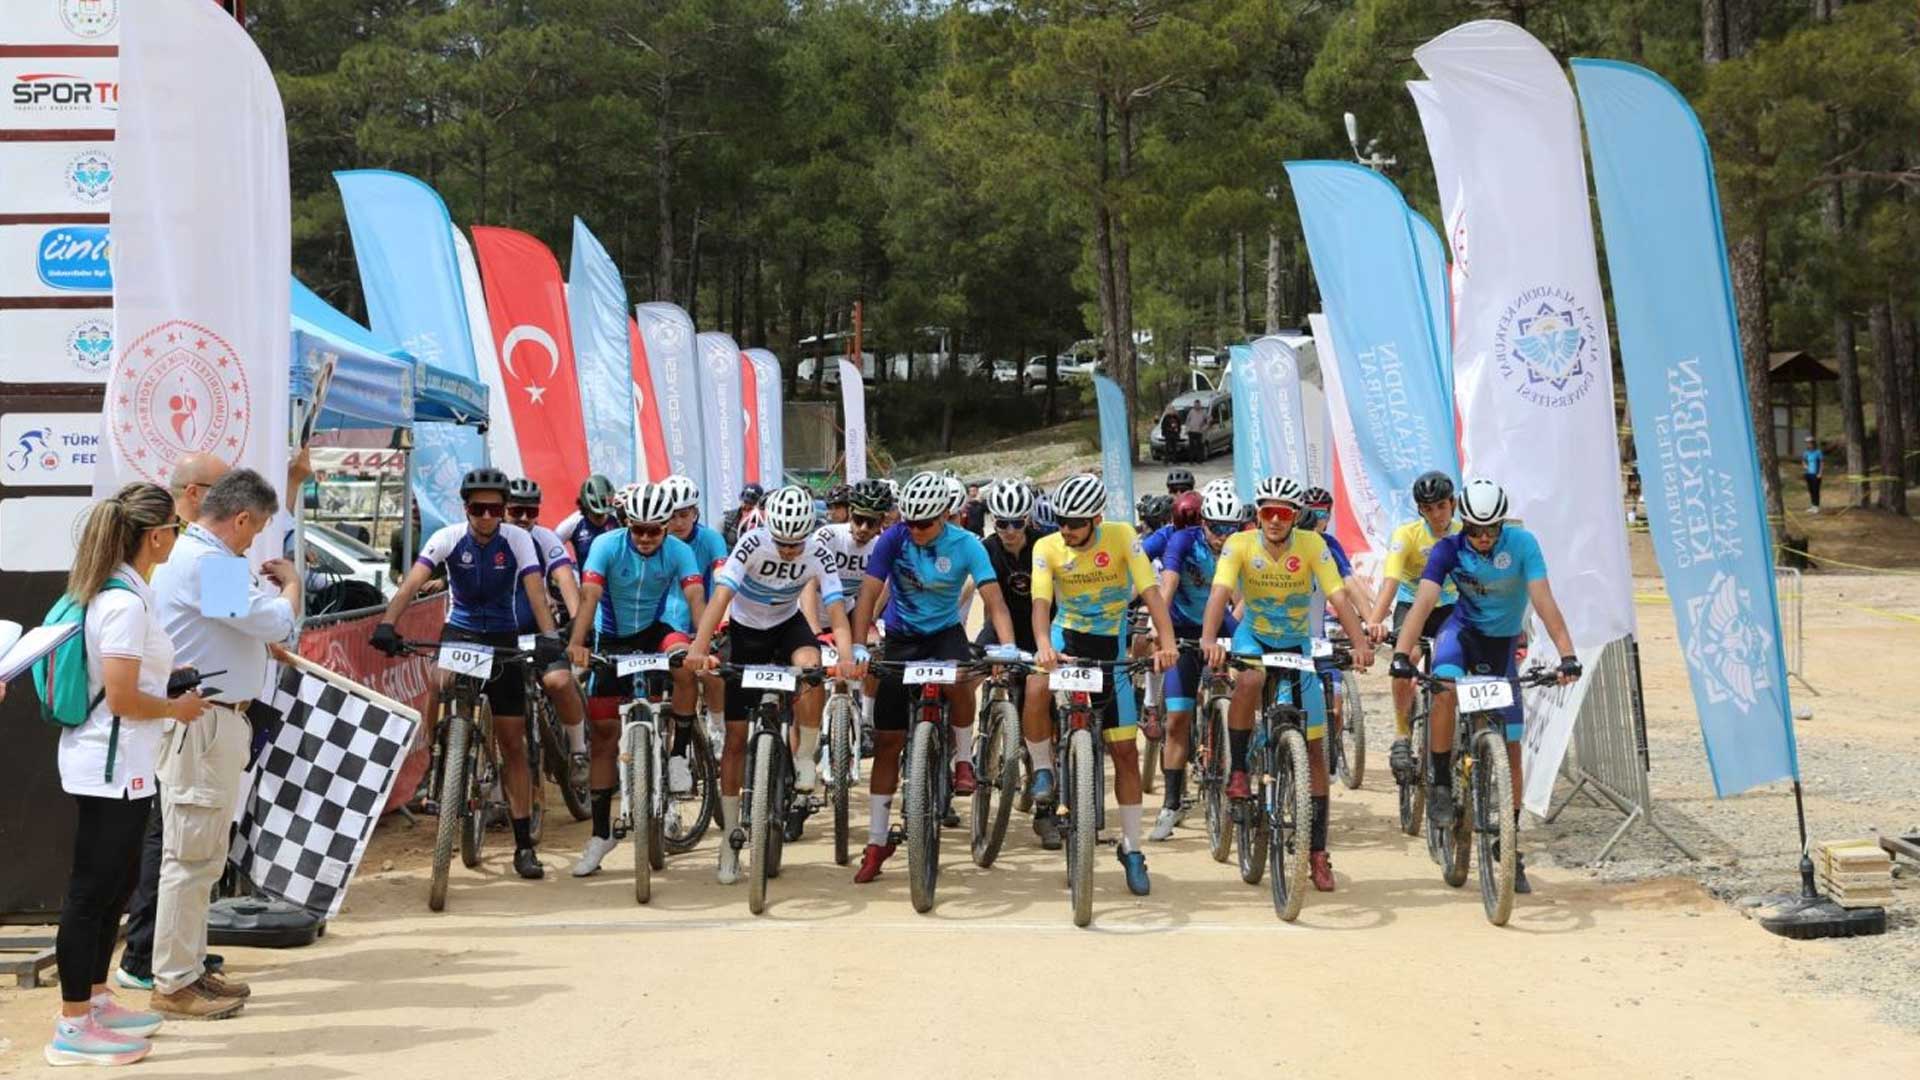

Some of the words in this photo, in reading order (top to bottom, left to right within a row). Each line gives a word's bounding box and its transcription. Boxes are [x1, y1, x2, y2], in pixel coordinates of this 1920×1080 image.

[735, 534, 761, 564] DEU
[813, 547, 837, 574] DEU
[760, 560, 806, 580] DEU
[452, 650, 480, 666] 001
[755, 672, 783, 682] 021
[915, 668, 944, 678] 014
[1061, 670, 1091, 680] 046
[1470, 685, 1499, 699] 012
